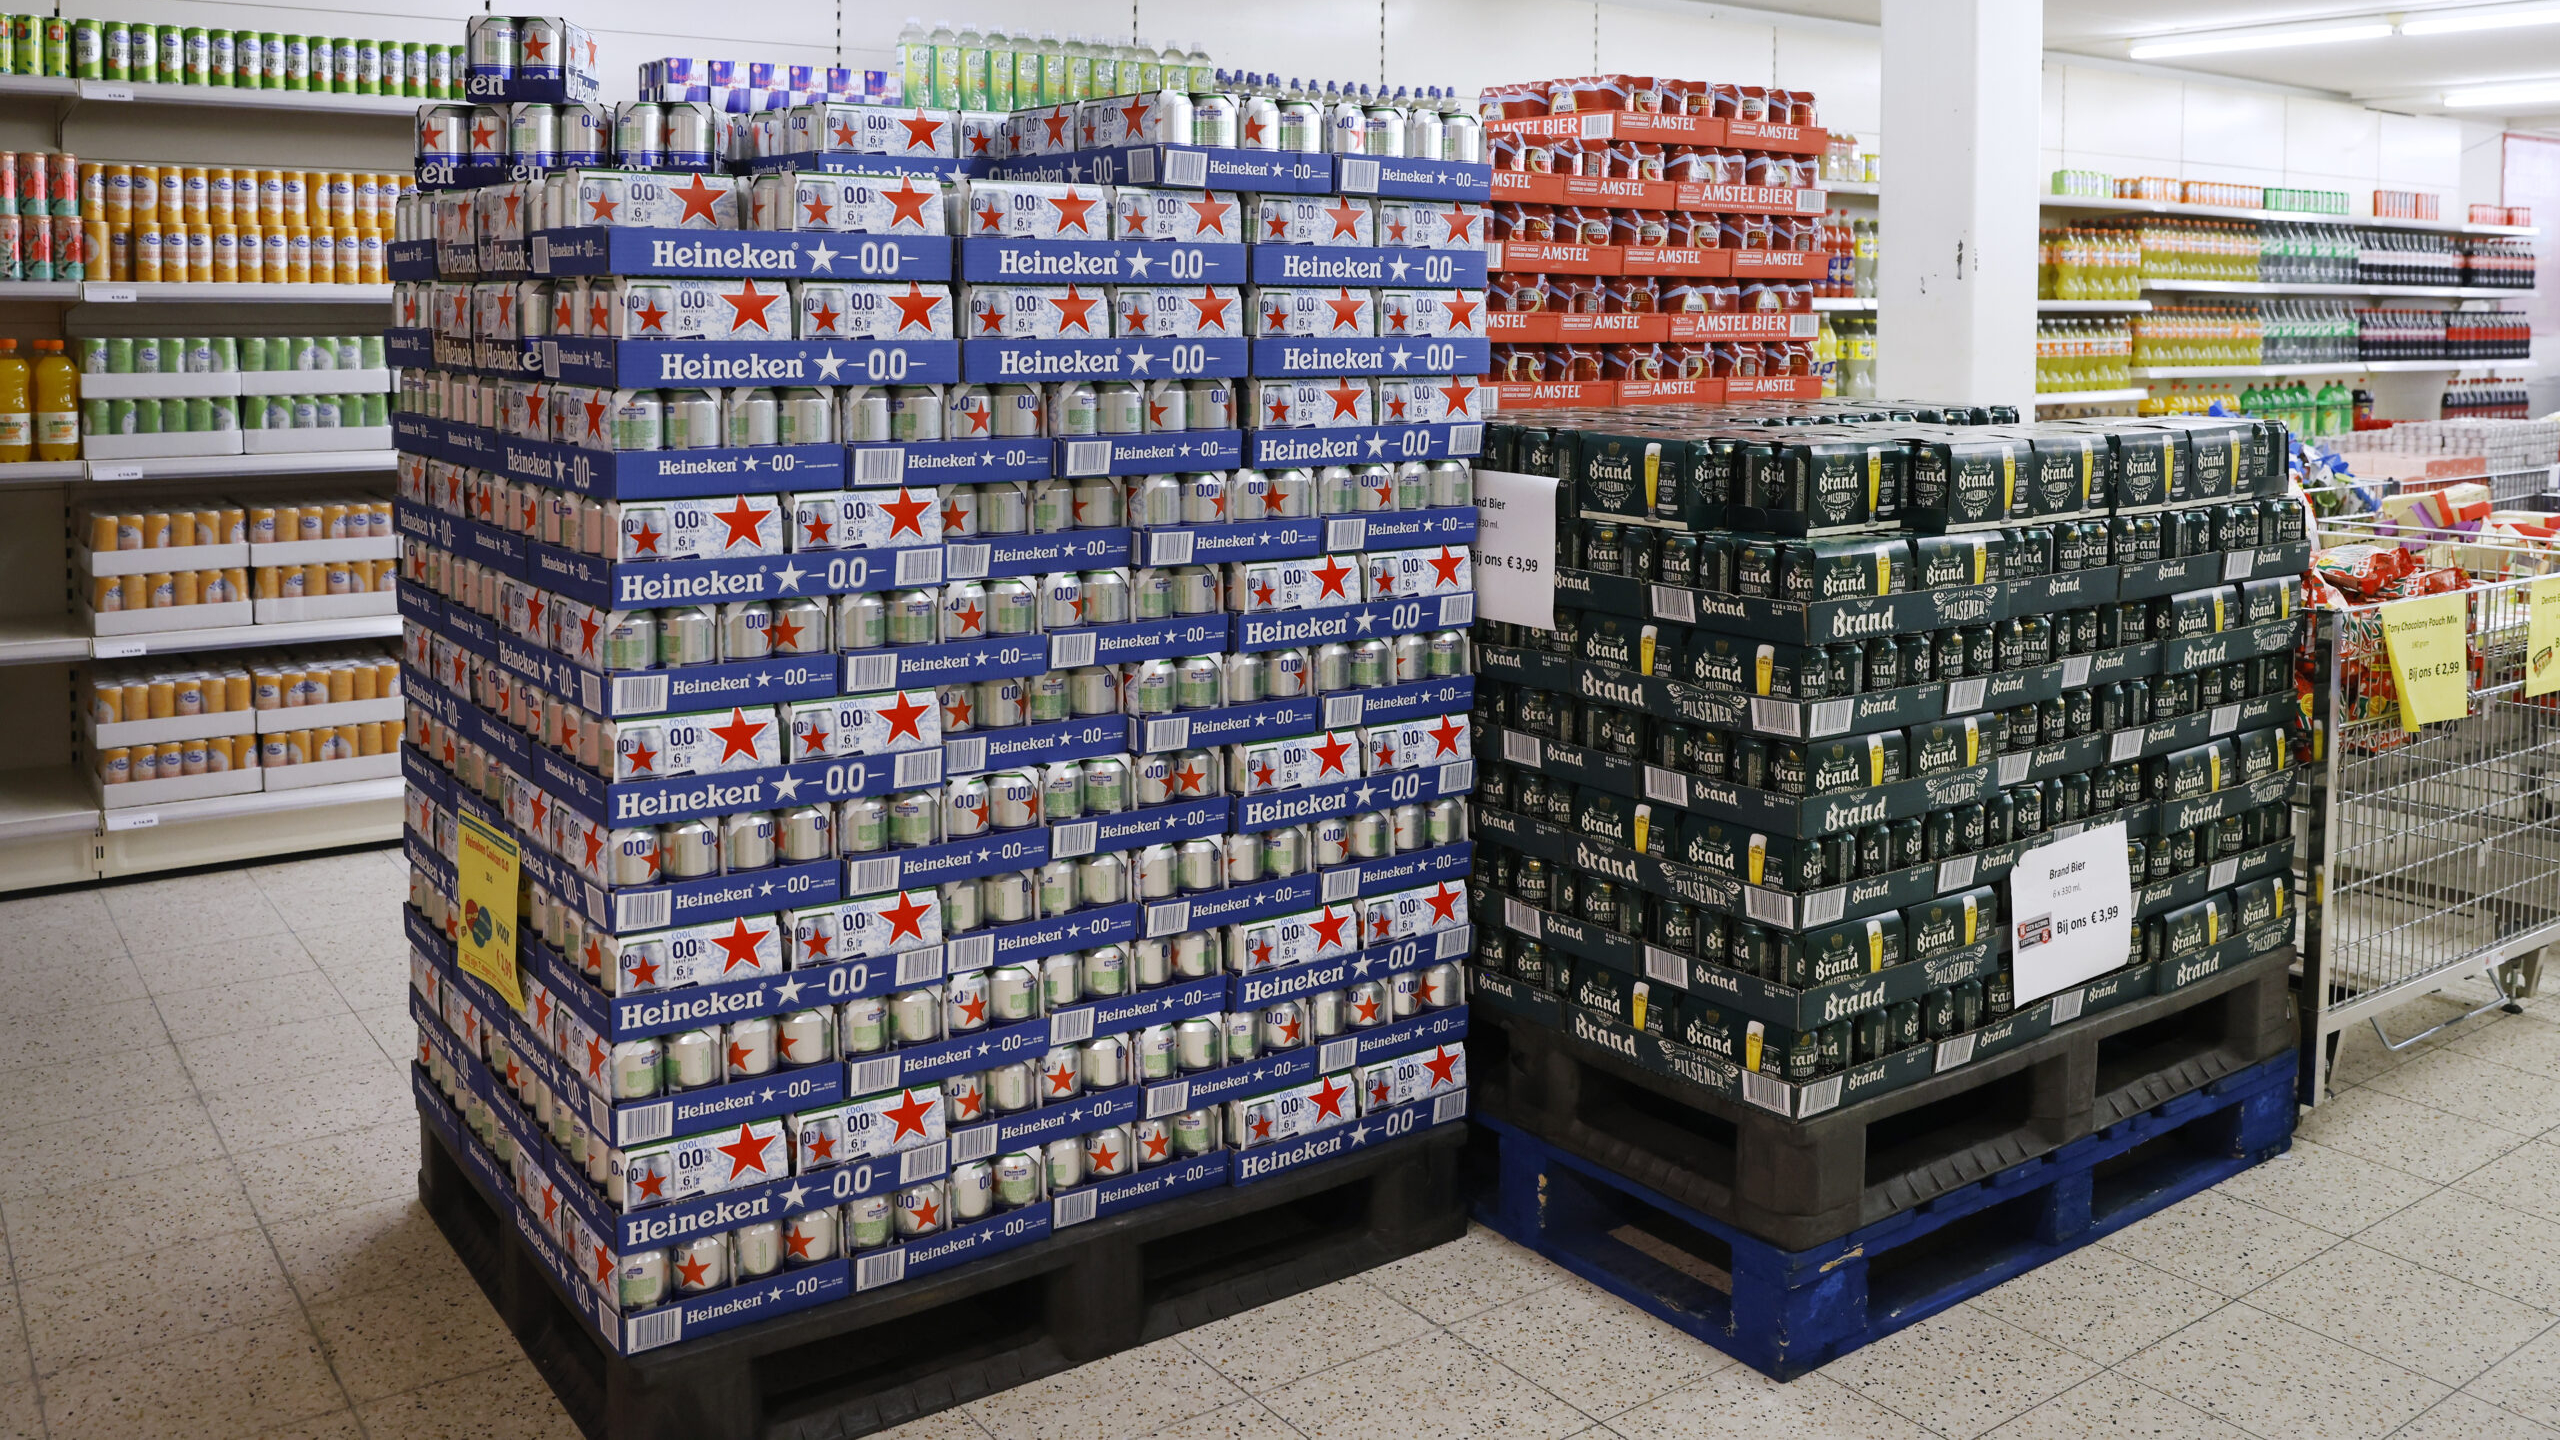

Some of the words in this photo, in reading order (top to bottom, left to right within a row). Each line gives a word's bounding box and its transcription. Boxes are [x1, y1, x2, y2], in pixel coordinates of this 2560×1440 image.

[1544, 118, 1577, 134] BIER
[1651, 116, 1696, 130] AMSTEL
[1759, 126, 1800, 140] AMSTEL
[1210, 160, 1268, 176] Heineken
[1294, 164, 1310, 178] 0.0
[1382, 168, 1433, 183] Heineken
[1456, 173, 1471, 187] 0.0
[631, 183, 655, 201] 0.0
[1600, 181, 1644, 196] AMSTEL
[1702, 185, 1755, 202] AMSTEL
[1759, 188, 1792, 204] BIER
[635, 207, 641, 218] 6
[549, 243, 574, 257] Heineken
[653, 241, 796, 268] Heineken
[861, 242, 898, 274] 0.0
[1541, 247, 1589, 261] AMSTEL
[1658, 250, 1700, 264] AMSTEL
[1764, 253, 1804, 266] AMSTEL
[1000, 250, 1119, 274] Heineken
[1172, 250, 1202, 278] 0.0
[1284, 256, 1382, 278] Heineken
[1426, 256, 1452, 282] 0.0
[1594, 316, 1640, 329] AMSTEL
[1696, 315, 1749, 331] AMSTEL
[1752, 316, 1786, 330] BIER
[661, 353, 803, 379] Heineken
[869, 348, 905, 380] 0.0
[1001, 351, 1119, 374] Heineken
[1172, 345, 1204, 373] 0.0
[1283, 347, 1383, 369] Heineken
[1427, 344, 1454, 370] 0.0
[1534, 385, 1581, 398] AMSTEL
[1653, 382, 1696, 394] AMSTEL
[1260, 437, 1359, 461] Heineken
[1402, 431, 1429, 456] 0.0
[507, 448, 552, 478] Heineken
[659, 459, 736, 475] Heineken
[772, 454, 794, 471] 0.0
[908, 453, 976, 468] Heineken
[1007, 450, 1025, 466] 0.0
[1590, 459, 1632, 480] Brand
[1819, 472, 1858, 490] Brand
[1959, 470, 1994, 490] Brand
[2041, 464, 2073, 483] Brand
[1472, 496, 1487, 508] and
[1489, 497, 1506, 510] Bier
[400, 508, 428, 533] Heineken
[1196, 534, 1255, 549] Heineken
[1281, 530, 1297, 544] 0.0
[1484, 555, 1502, 567] ons
[1507, 556, 1513, 568] €
[1516, 557, 1538, 573] 3,99
[2159, 563, 2185, 580] Brand
[620, 570, 764, 601] Heineken
[828, 558, 866, 589] 0.0
[1944, 600, 1984, 620] PILSENER
[2446, 614, 2458, 625] Mix
[1246, 614, 1347, 644] Heineken
[1392, 603, 1420, 629] 0.0
[1833, 606, 1894, 637] Brand
[499, 640, 539, 680] Heineken
[901, 656, 969, 672] Heineken
[1000, 648, 1019, 664] 0.0
[2184, 641, 2226, 668] Brand
[2408, 667, 2418, 682] Bij
[2418, 667, 2432, 678] ons
[2435, 664, 2441, 676] €
[2442, 661, 2459, 676] 2,99
[1582, 670, 1644, 706] Brand
[1992, 676, 2024, 695] Brand
[1192, 718, 1250, 734] Heineken
[1276, 709, 1292, 724] 0.0
[1683, 701, 1733, 723] PILSENER
[670, 727, 695, 747] 0.0
[2149, 726, 2175, 743] Brand
[674, 753, 681, 763] 6
[617, 784, 760, 819] Heineken
[826, 763, 865, 795] 0.0
[1246, 794, 1346, 825] Heineken
[1392, 774, 1419, 800] 0.0
[1696, 782, 1737, 805] Brand
[1935, 784, 1975, 804] PILSENER
[1825, 797, 1887, 832] Brand
[2180, 799, 2222, 829] Brand
[904, 855, 971, 874] Heineken
[1002, 842, 1021, 859] 0.0
[1578, 842, 1638, 882] Brand
[2049, 863, 2069, 880] Brand
[2071, 861, 2086, 872] Bier
[2061, 885, 2072, 896] 330
[1547, 917, 1583, 941] Brand
[2057, 919, 2068, 935] Bij
[2070, 917, 2087, 930] ons
[2091, 911, 2097, 923] €
[2099, 905, 2118, 923] 3,99
[1244, 964, 1344, 1002] Heineken
[1389, 942, 1416, 969] 0.0
[2177, 954, 2219, 986] Brand
[619, 986, 765, 1031] Heineken
[829, 968, 867, 996] 0.0
[1825, 984, 1885, 1021] Brand
[1576, 1012, 1636, 1057] Brand
[1981, 1024, 2012, 1047] Brand
[509, 1020, 550, 1076] Heineken
[1192, 1076, 1248, 1096] Heineken
[1275, 1062, 1290, 1076] 0.0
[1849, 1066, 1884, 1090] Brand
[1241, 1134, 1341, 1179] Heineken
[1386, 1109, 1413, 1136] 0.0
[626, 1195, 770, 1246] Heineken
[834, 1165, 871, 1198] 0.0
[516, 1207, 557, 1268] Heineken
